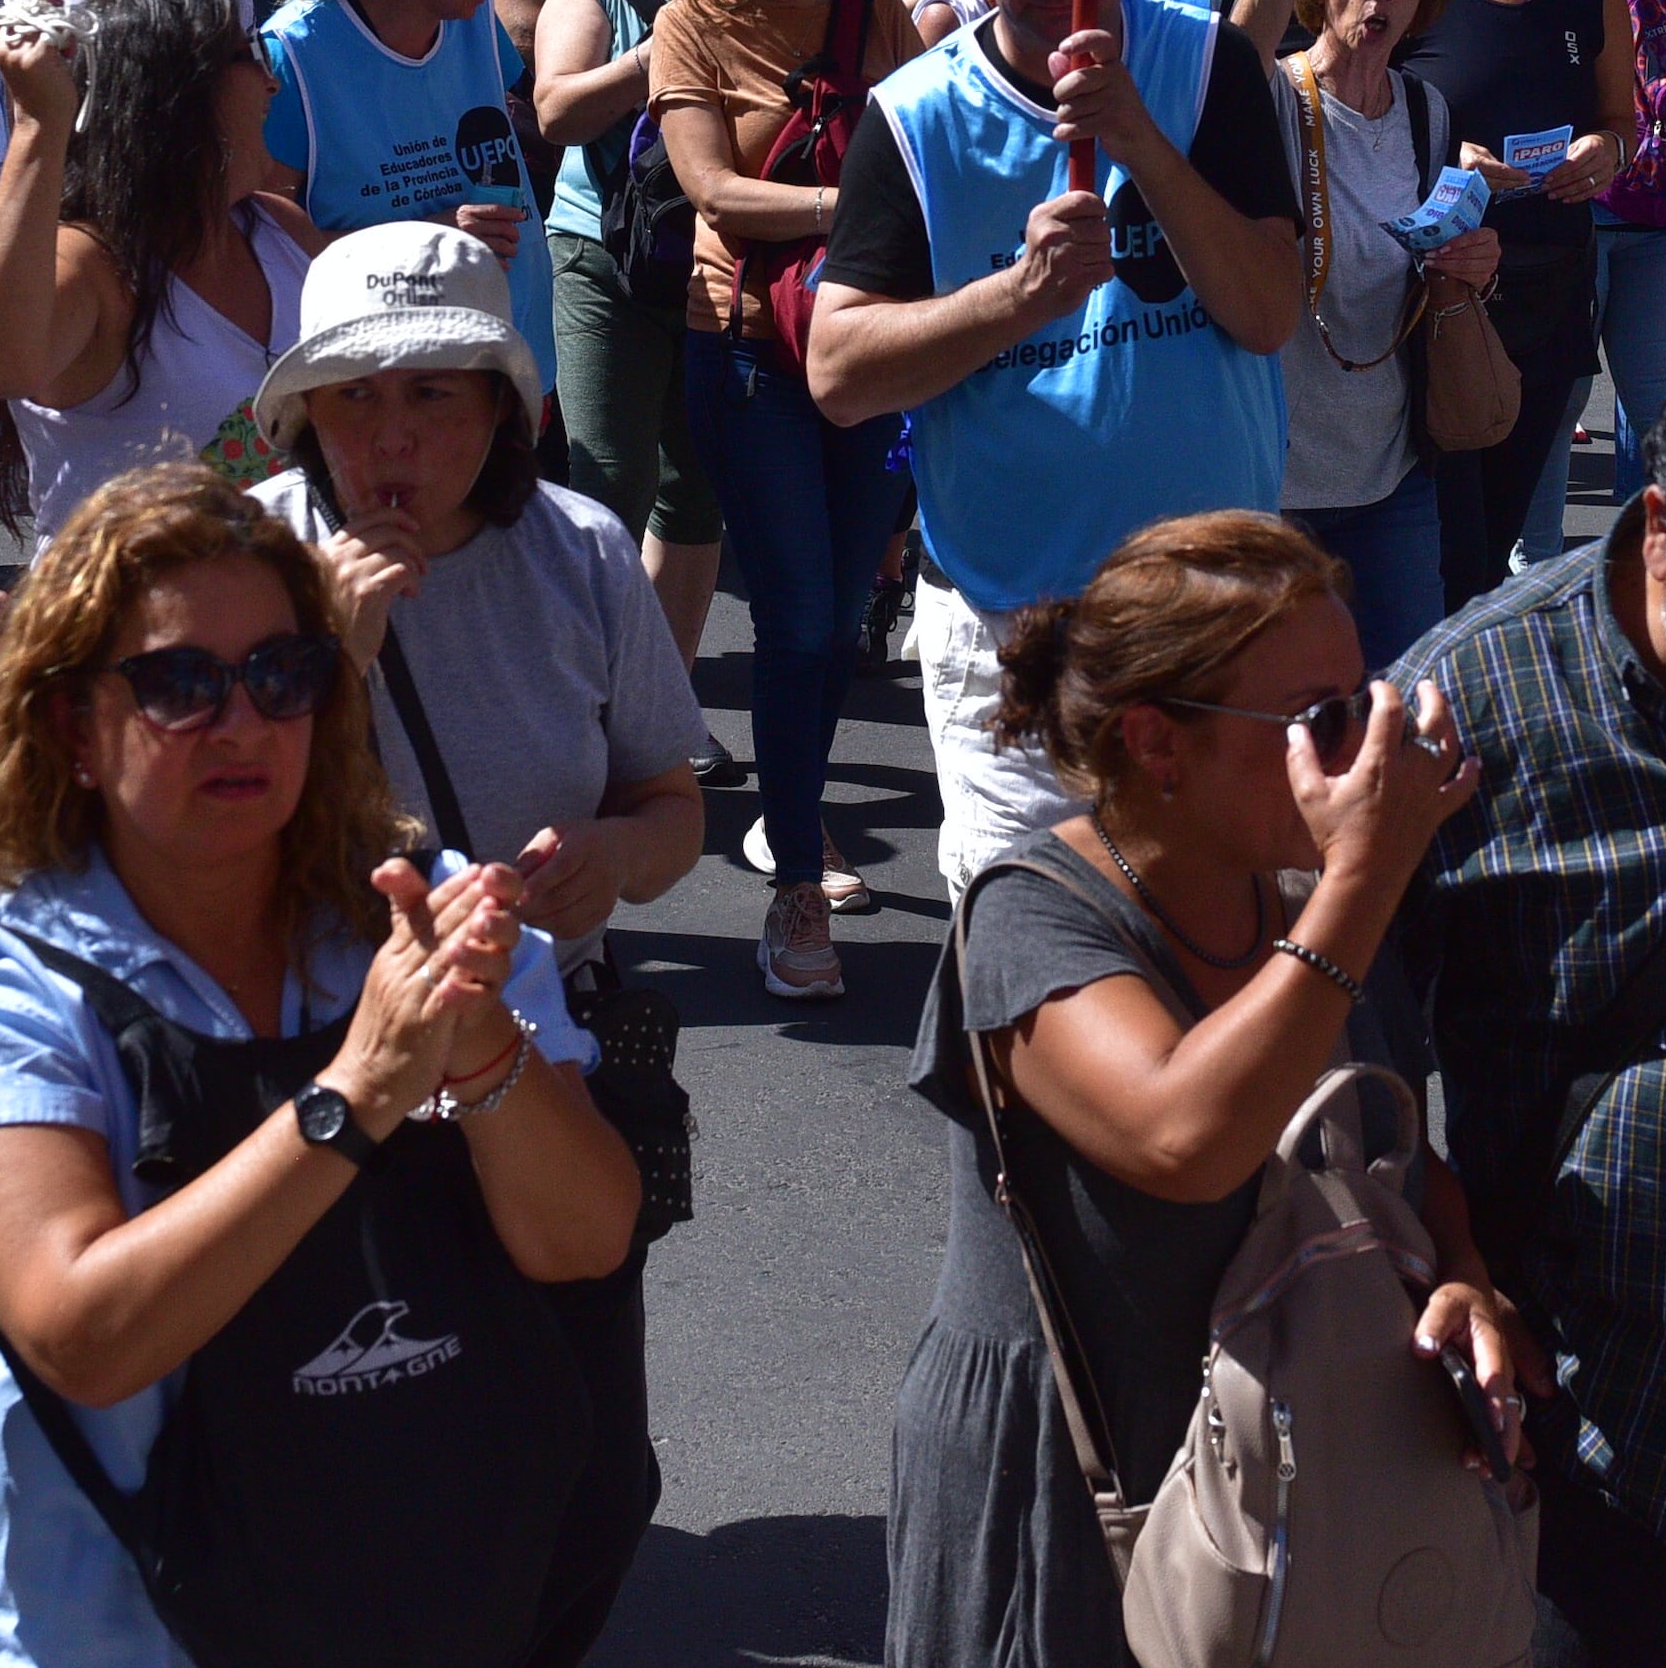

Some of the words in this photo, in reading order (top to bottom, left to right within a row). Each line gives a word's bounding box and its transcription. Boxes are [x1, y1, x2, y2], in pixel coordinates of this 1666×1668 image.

[1298, 87, 1317, 129] MAKE
[379, 150, 454, 177] Educadores
[392, 139, 431, 157] Unión
[432, 135, 448, 149] de
[360, 184, 381, 198] de
[385, 180, 400, 193] la
[402, 165, 460, 189] Provincia
[1307, 148, 1320, 185] LUCK
[391, 192, 410, 209] de
[413, 181, 463, 203] Córdoba
[1311, 192, 1324, 229] OWN
[1110, 221, 1165, 259] UEP
[1311, 235, 1325, 279] YOUR
[366, 271, 437, 290] DuPont
[1143, 298, 1215, 340] Unió
